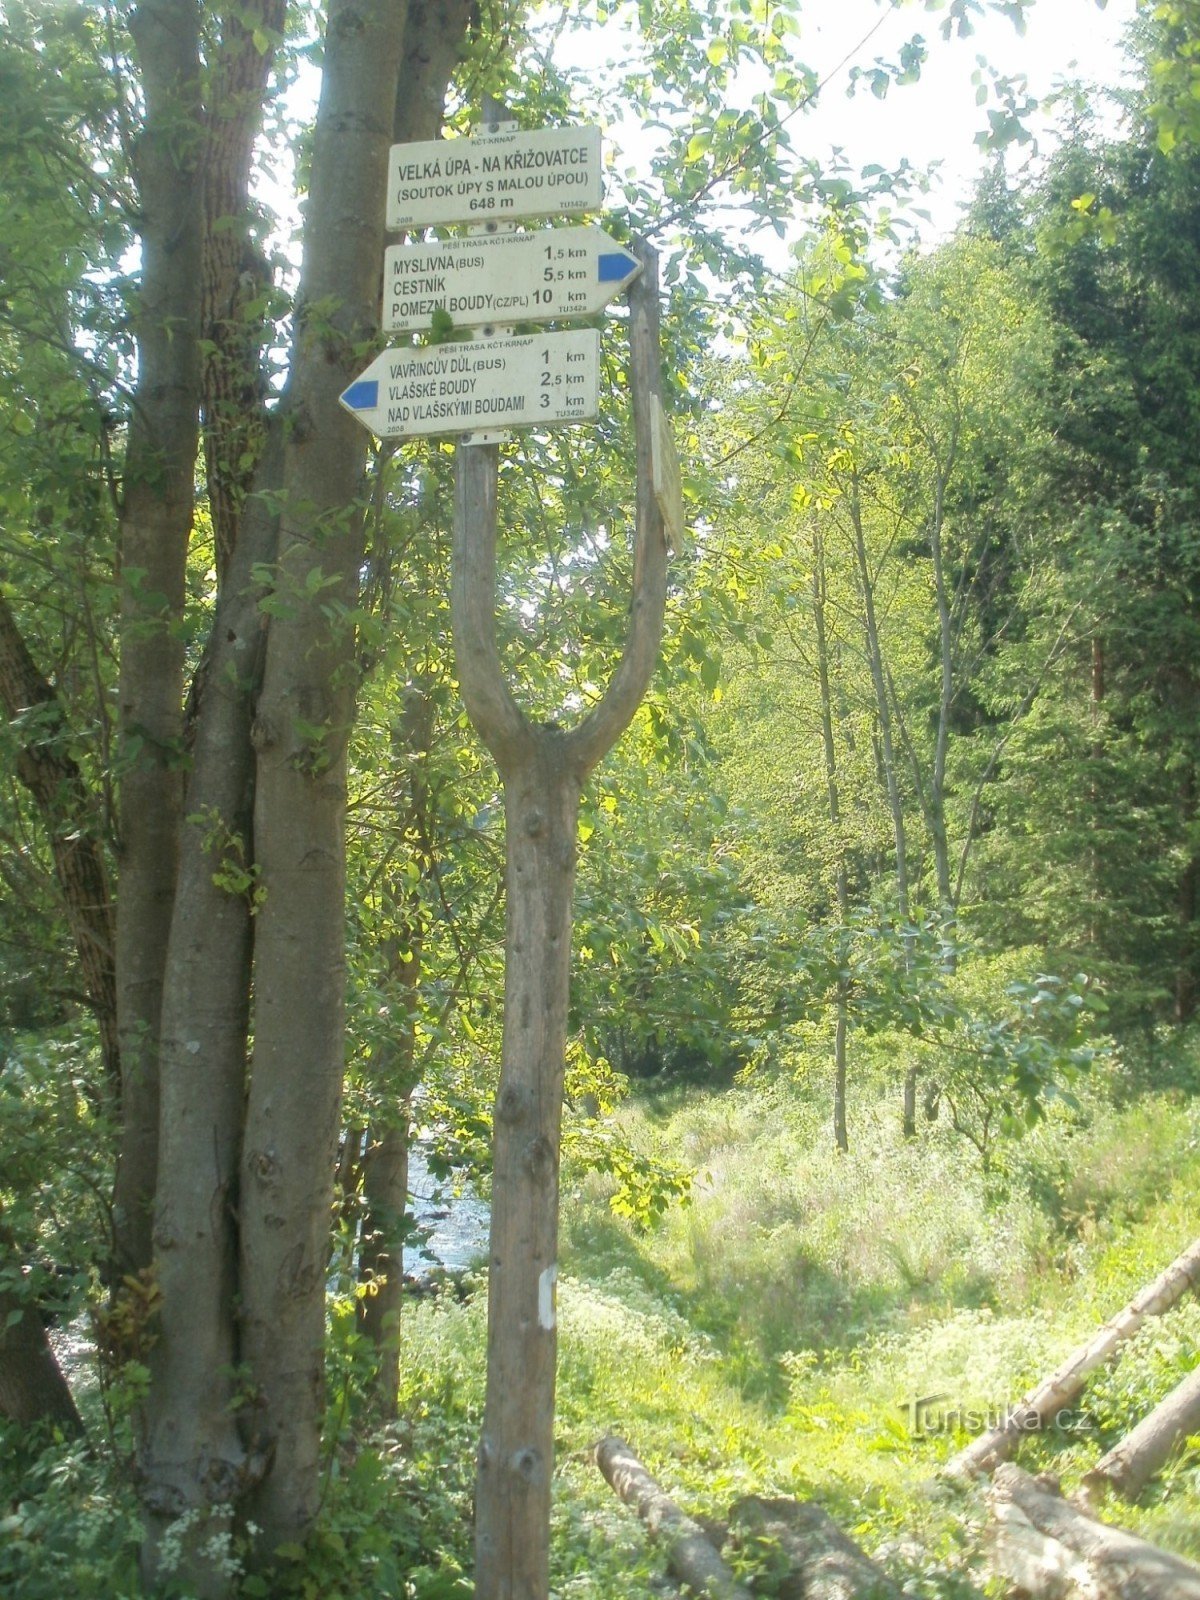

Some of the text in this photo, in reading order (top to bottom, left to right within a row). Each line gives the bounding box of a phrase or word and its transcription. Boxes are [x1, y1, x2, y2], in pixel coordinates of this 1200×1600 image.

[398, 161, 441, 181] VELKÁ
[446, 156, 471, 175] ÚPA
[482, 157, 500, 173] NA
[505, 147, 588, 171] KŘIŽOVATCE
[398, 170, 588, 204] (SOUTOK ÚPY S MALOU ÚPOU)
[469, 197, 514, 210] 648 m
[462, 239, 488, 248] TRASA
[544, 246, 564, 260] 1,5
[568, 248, 586, 258] km
[394, 268, 586, 296] CESTNÍK 5,5 km
[392, 296, 447, 316] POMEZNÍ
[532, 289, 552, 304] 10
[568, 291, 586, 302] km
[459, 343, 485, 352] TRASA
[487, 338, 534, 349] KČT-KRNAP
[541, 350, 550, 364] 1
[566, 352, 585, 362] km
[388, 372, 584, 400] VLAŠSKÉ BOUDY 2,5 km
[388, 394, 584, 423] NAD VLAŠSKÝMI BOUDAMI 3 km
